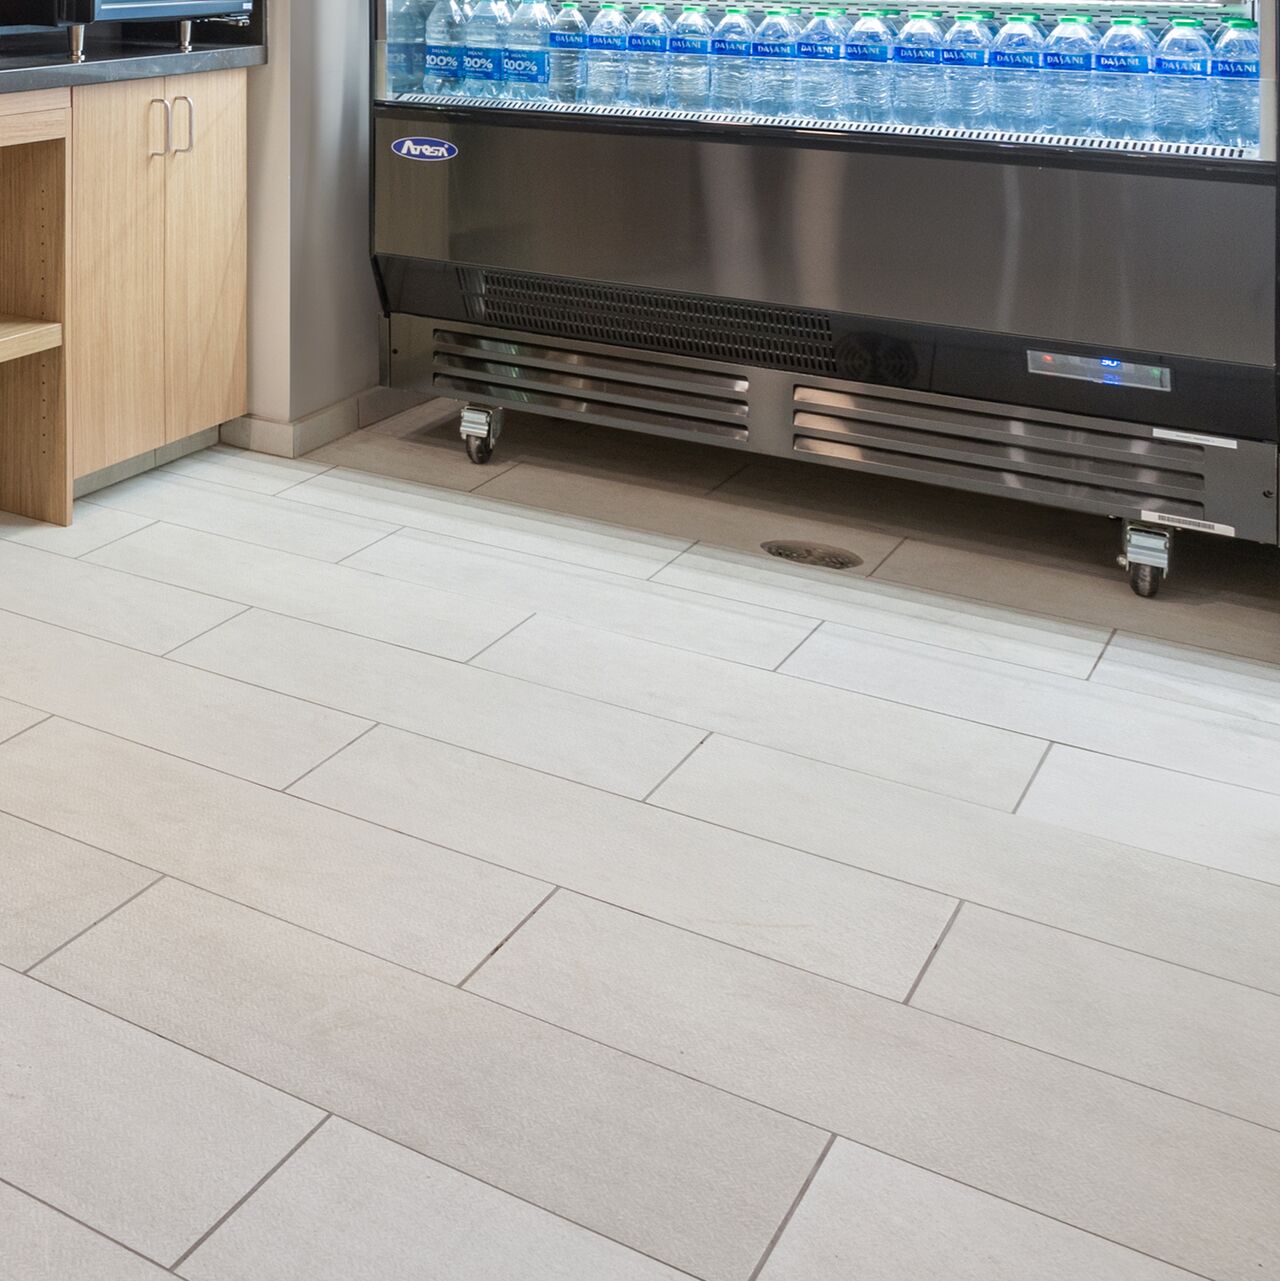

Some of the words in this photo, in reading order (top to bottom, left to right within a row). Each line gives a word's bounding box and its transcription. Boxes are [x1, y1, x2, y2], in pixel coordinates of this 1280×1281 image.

[555, 35, 584, 43] DASANI
[592, 36, 622, 45] DASANI
[631, 38, 661, 47] DASANI
[672, 40, 701, 48] DASANI
[757, 45, 790, 53] DASANI
[801, 45, 834, 54] DASANI
[847, 45, 880, 56] DASANI
[900, 48, 935, 59] DASANI
[943, 49, 977, 60] DASANI
[464, 56, 493, 69] 00%
[997, 53, 1034, 64] DASANI
[1046, 54, 1084, 65] DASANI
[1101, 56, 1140, 67] DASANI
[1162, 60, 1202, 72] DASANI
[1217, 61, 1258, 73] DASANI
